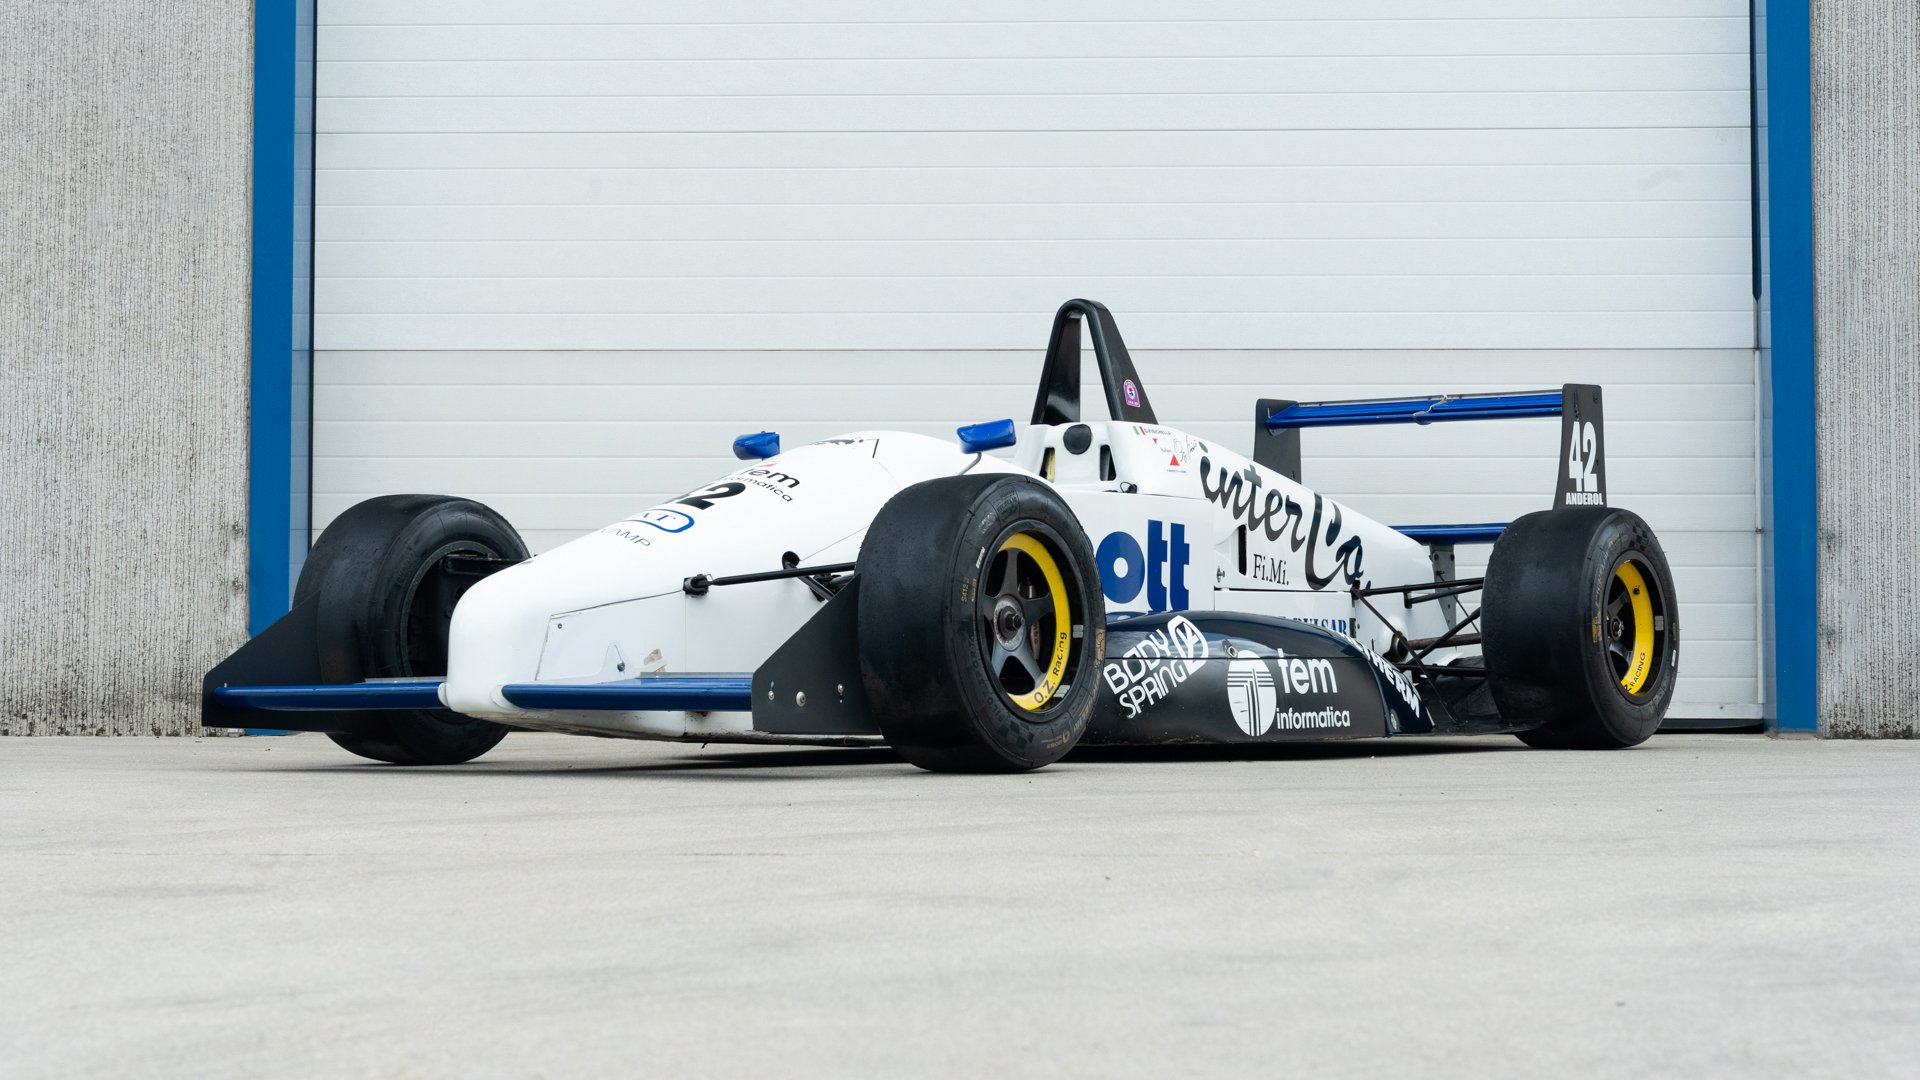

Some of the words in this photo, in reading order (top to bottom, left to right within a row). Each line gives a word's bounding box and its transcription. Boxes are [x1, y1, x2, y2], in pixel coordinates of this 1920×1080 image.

[1569, 421, 1597, 492] 42
[672, 481, 746, 510] 2
[738, 467, 800, 489] em
[1565, 492, 1604, 505] ANDEROL
[1083, 519, 1190, 613] ott
[1253, 553, 1290, 586] Fi.Mi.
[1033, 679, 1057, 704] O.Z.
[1052, 632, 1067, 676] Racing
[1103, 628, 1172, 695] BODY
[1277, 648, 1338, 694] tem
[1629, 652, 1646, 687] RACING
[1119, 656, 1188, 719] SPRING
[1276, 706, 1351, 729] informatica
